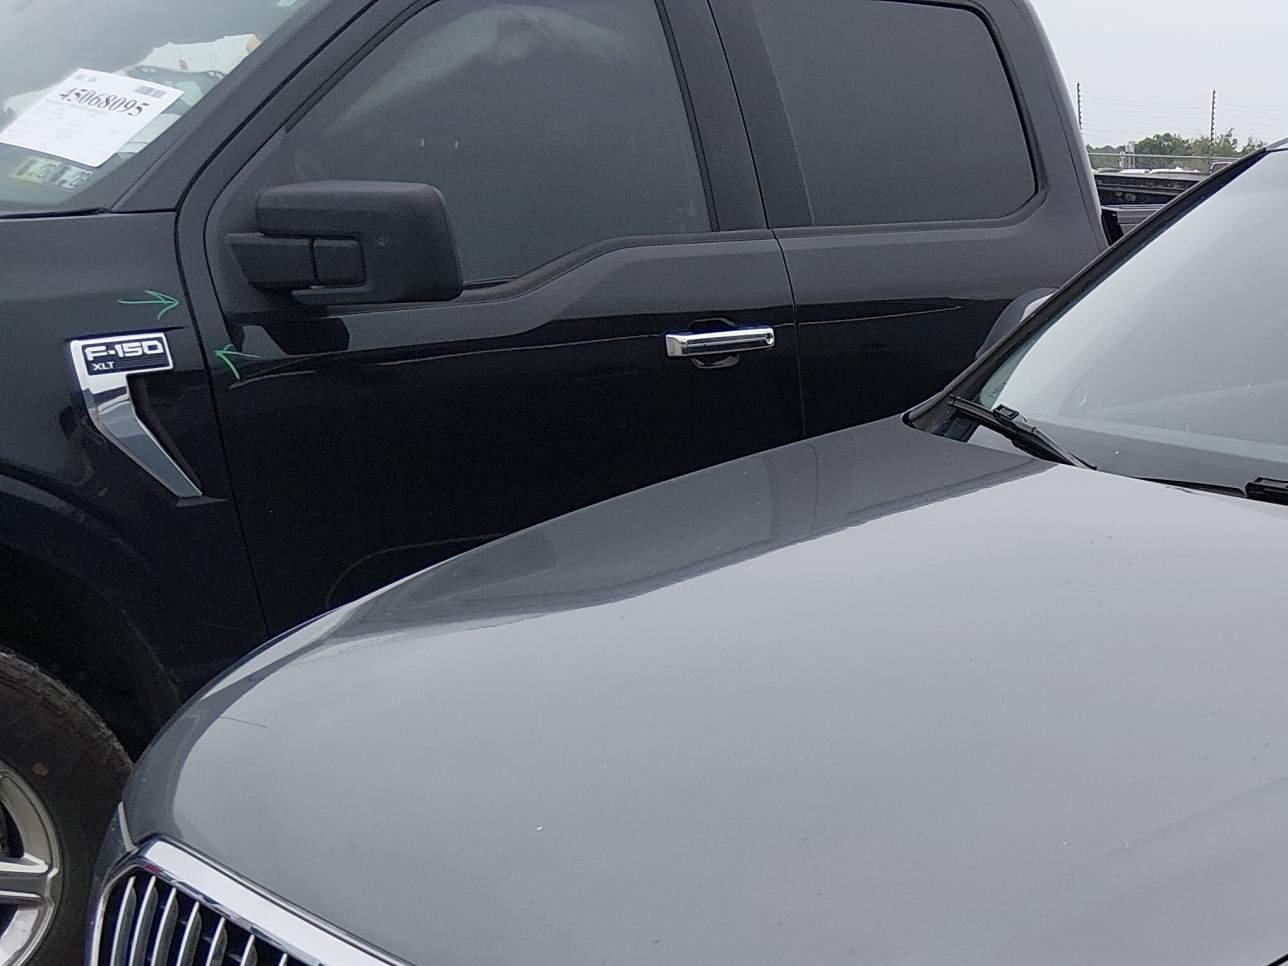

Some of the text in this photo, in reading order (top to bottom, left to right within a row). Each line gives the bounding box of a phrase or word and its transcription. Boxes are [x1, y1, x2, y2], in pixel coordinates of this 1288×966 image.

[59, 87, 151, 117] 45068095
[84, 340, 164, 361] F-150
[92, 361, 115, 371] XLT
